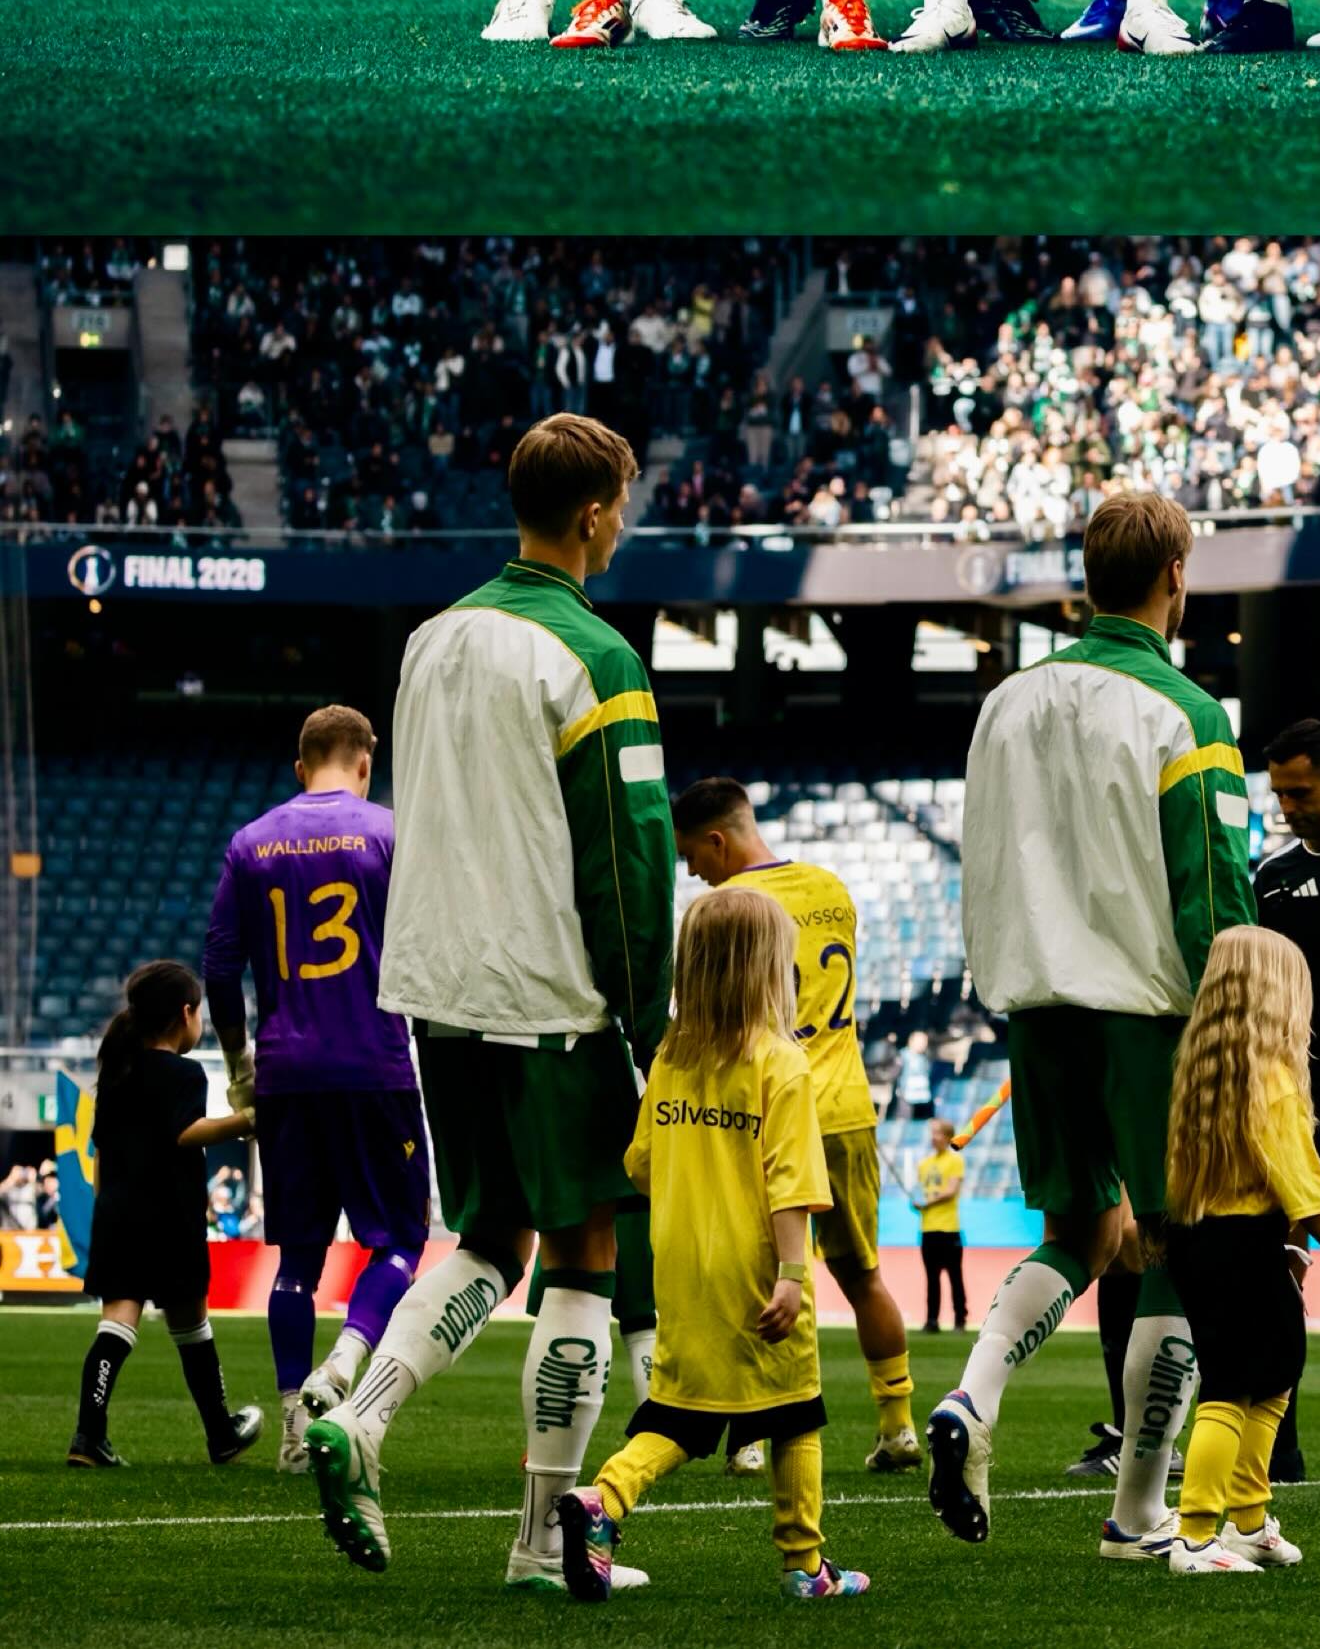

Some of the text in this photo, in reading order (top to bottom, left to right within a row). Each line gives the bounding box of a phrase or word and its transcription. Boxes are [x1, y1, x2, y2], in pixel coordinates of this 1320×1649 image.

[124, 555, 265, 591] FINAL 2026
[256, 835, 367, 860] WALLINDER
[269, 881, 361, 981] 13
[97, 1359, 111, 1400] CRAFT
